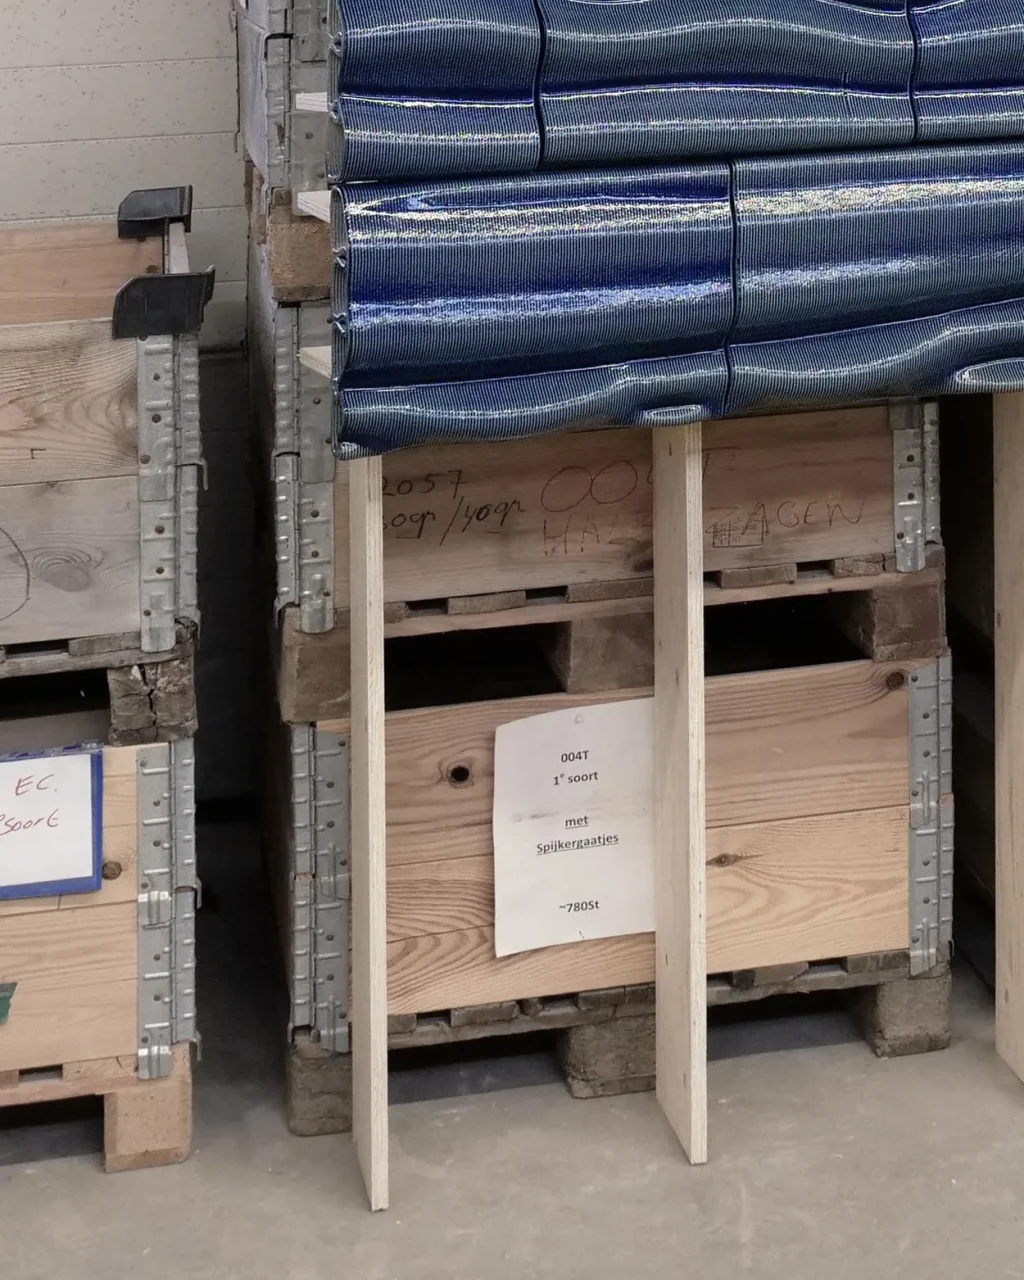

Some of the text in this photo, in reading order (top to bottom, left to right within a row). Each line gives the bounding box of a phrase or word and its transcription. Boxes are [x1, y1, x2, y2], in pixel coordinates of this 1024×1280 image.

[560, 750, 590, 763] 004T
[567, 771, 599, 784] soort
[565, 815, 589, 829] met
[536, 833, 620, 855] Spijkergaatjes
